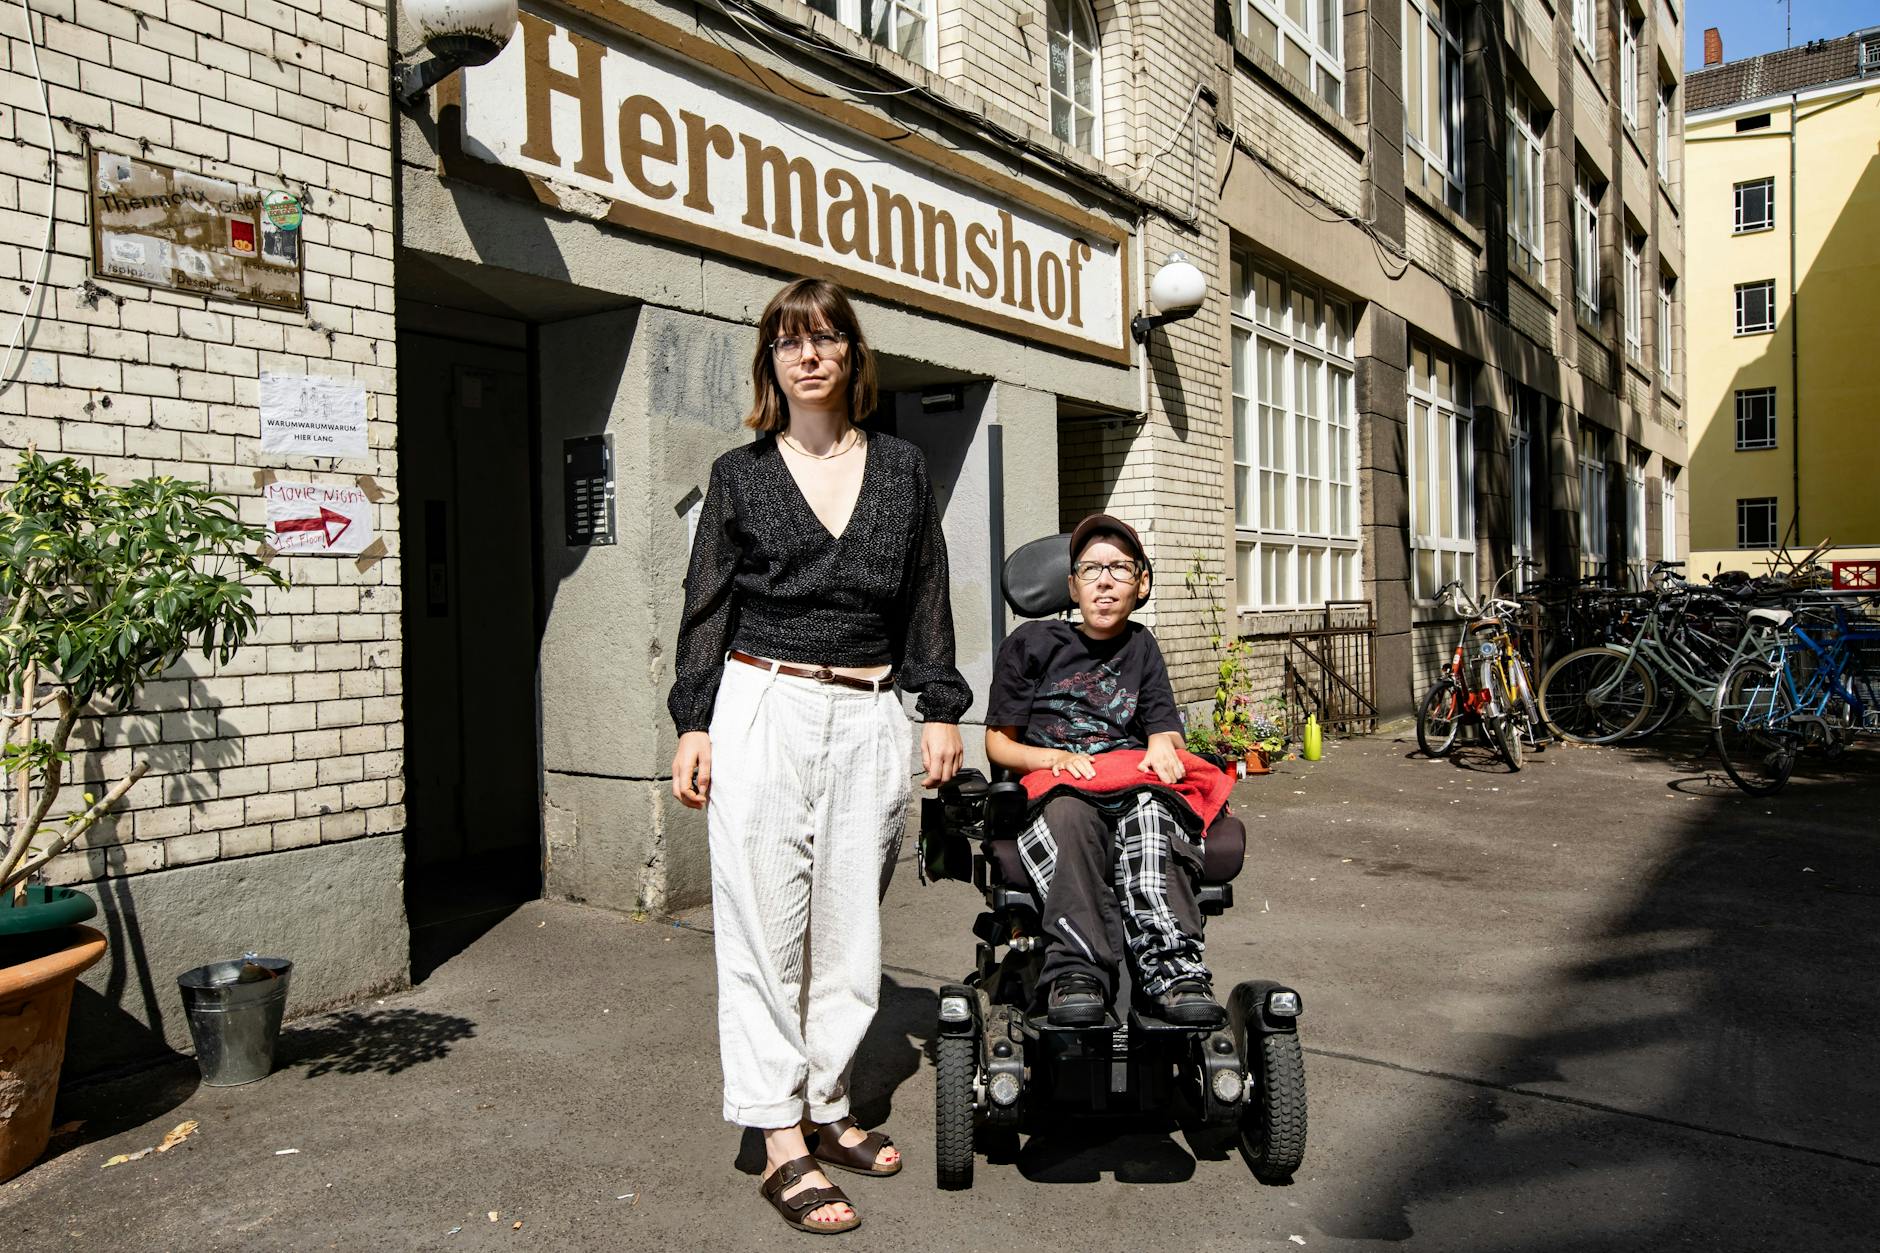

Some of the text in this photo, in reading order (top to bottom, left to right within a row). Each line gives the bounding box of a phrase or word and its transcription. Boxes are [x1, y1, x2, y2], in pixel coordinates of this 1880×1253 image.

[518, 11, 1091, 328] Hermannshof
[267, 419, 357, 432] WARUMWARUMWARUM
[313, 435, 334, 443] LANG
[269, 485, 316, 501] Movie
